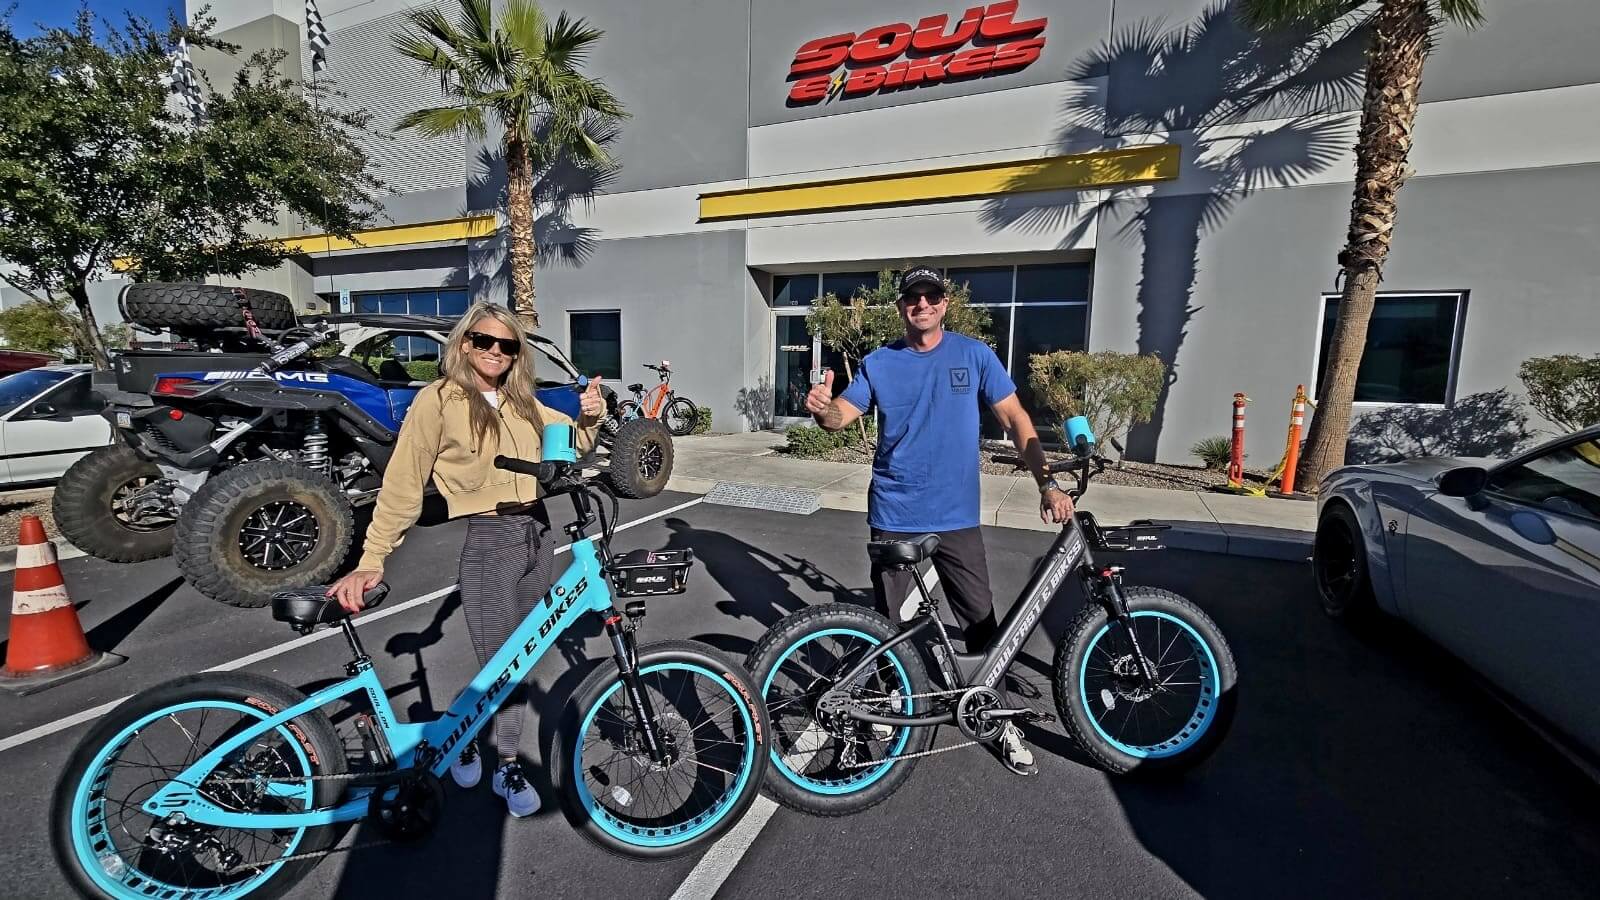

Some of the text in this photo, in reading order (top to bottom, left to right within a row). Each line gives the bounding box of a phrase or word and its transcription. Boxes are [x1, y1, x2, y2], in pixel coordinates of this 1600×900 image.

[788, 0, 1048, 75] SOUL
[843, 37, 1047, 96] BIKES
[984, 539, 1082, 688] SOULFAST E BIKES
[431, 576, 589, 769] SOULFAST E BIKES
